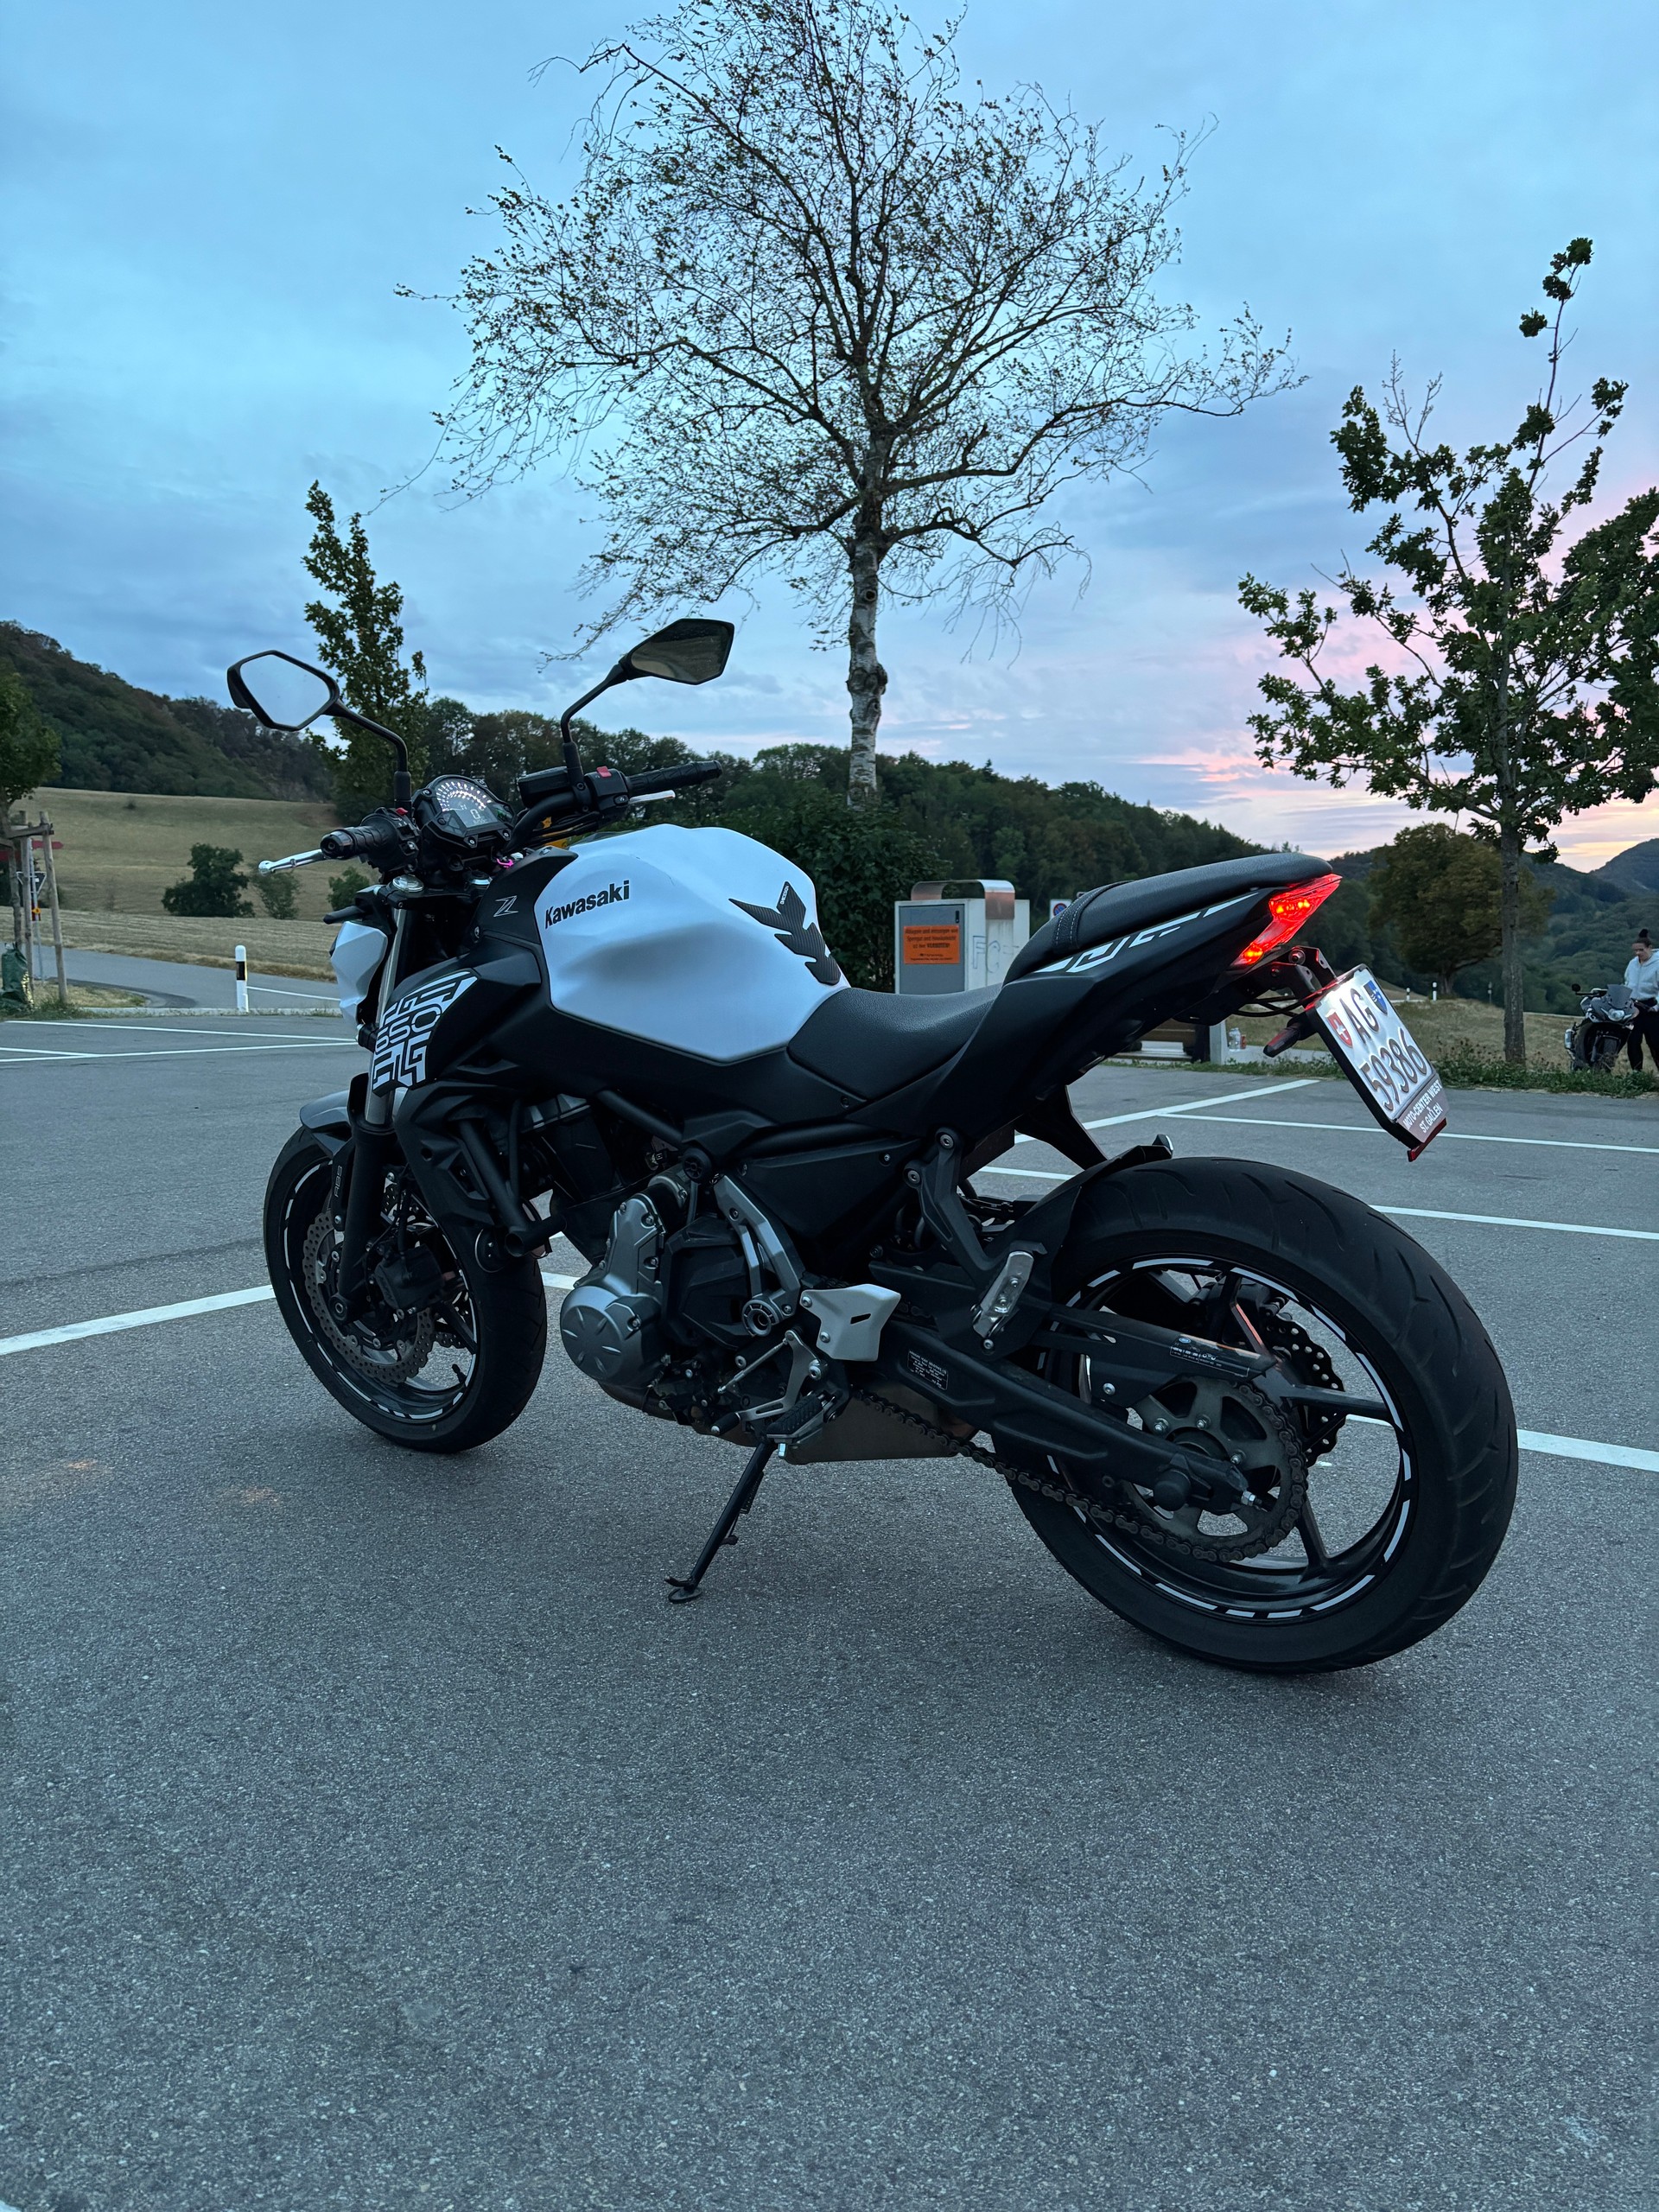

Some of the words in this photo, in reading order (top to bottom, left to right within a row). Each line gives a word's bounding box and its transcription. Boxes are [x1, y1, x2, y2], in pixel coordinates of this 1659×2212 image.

[544, 880, 630, 929] Kawasaki
[374, 1006, 442, 1053] 650
[1339, 988, 1380, 1046] AG
[1359, 1028, 1427, 1111] 59386
[1402, 1092, 1433, 1130] MOTO-CENTER
[1427, 1079, 1443, 1098] WEST
[1424, 1102, 1444, 1126] GALLEN
[334, 1165, 343, 1198] ABS
